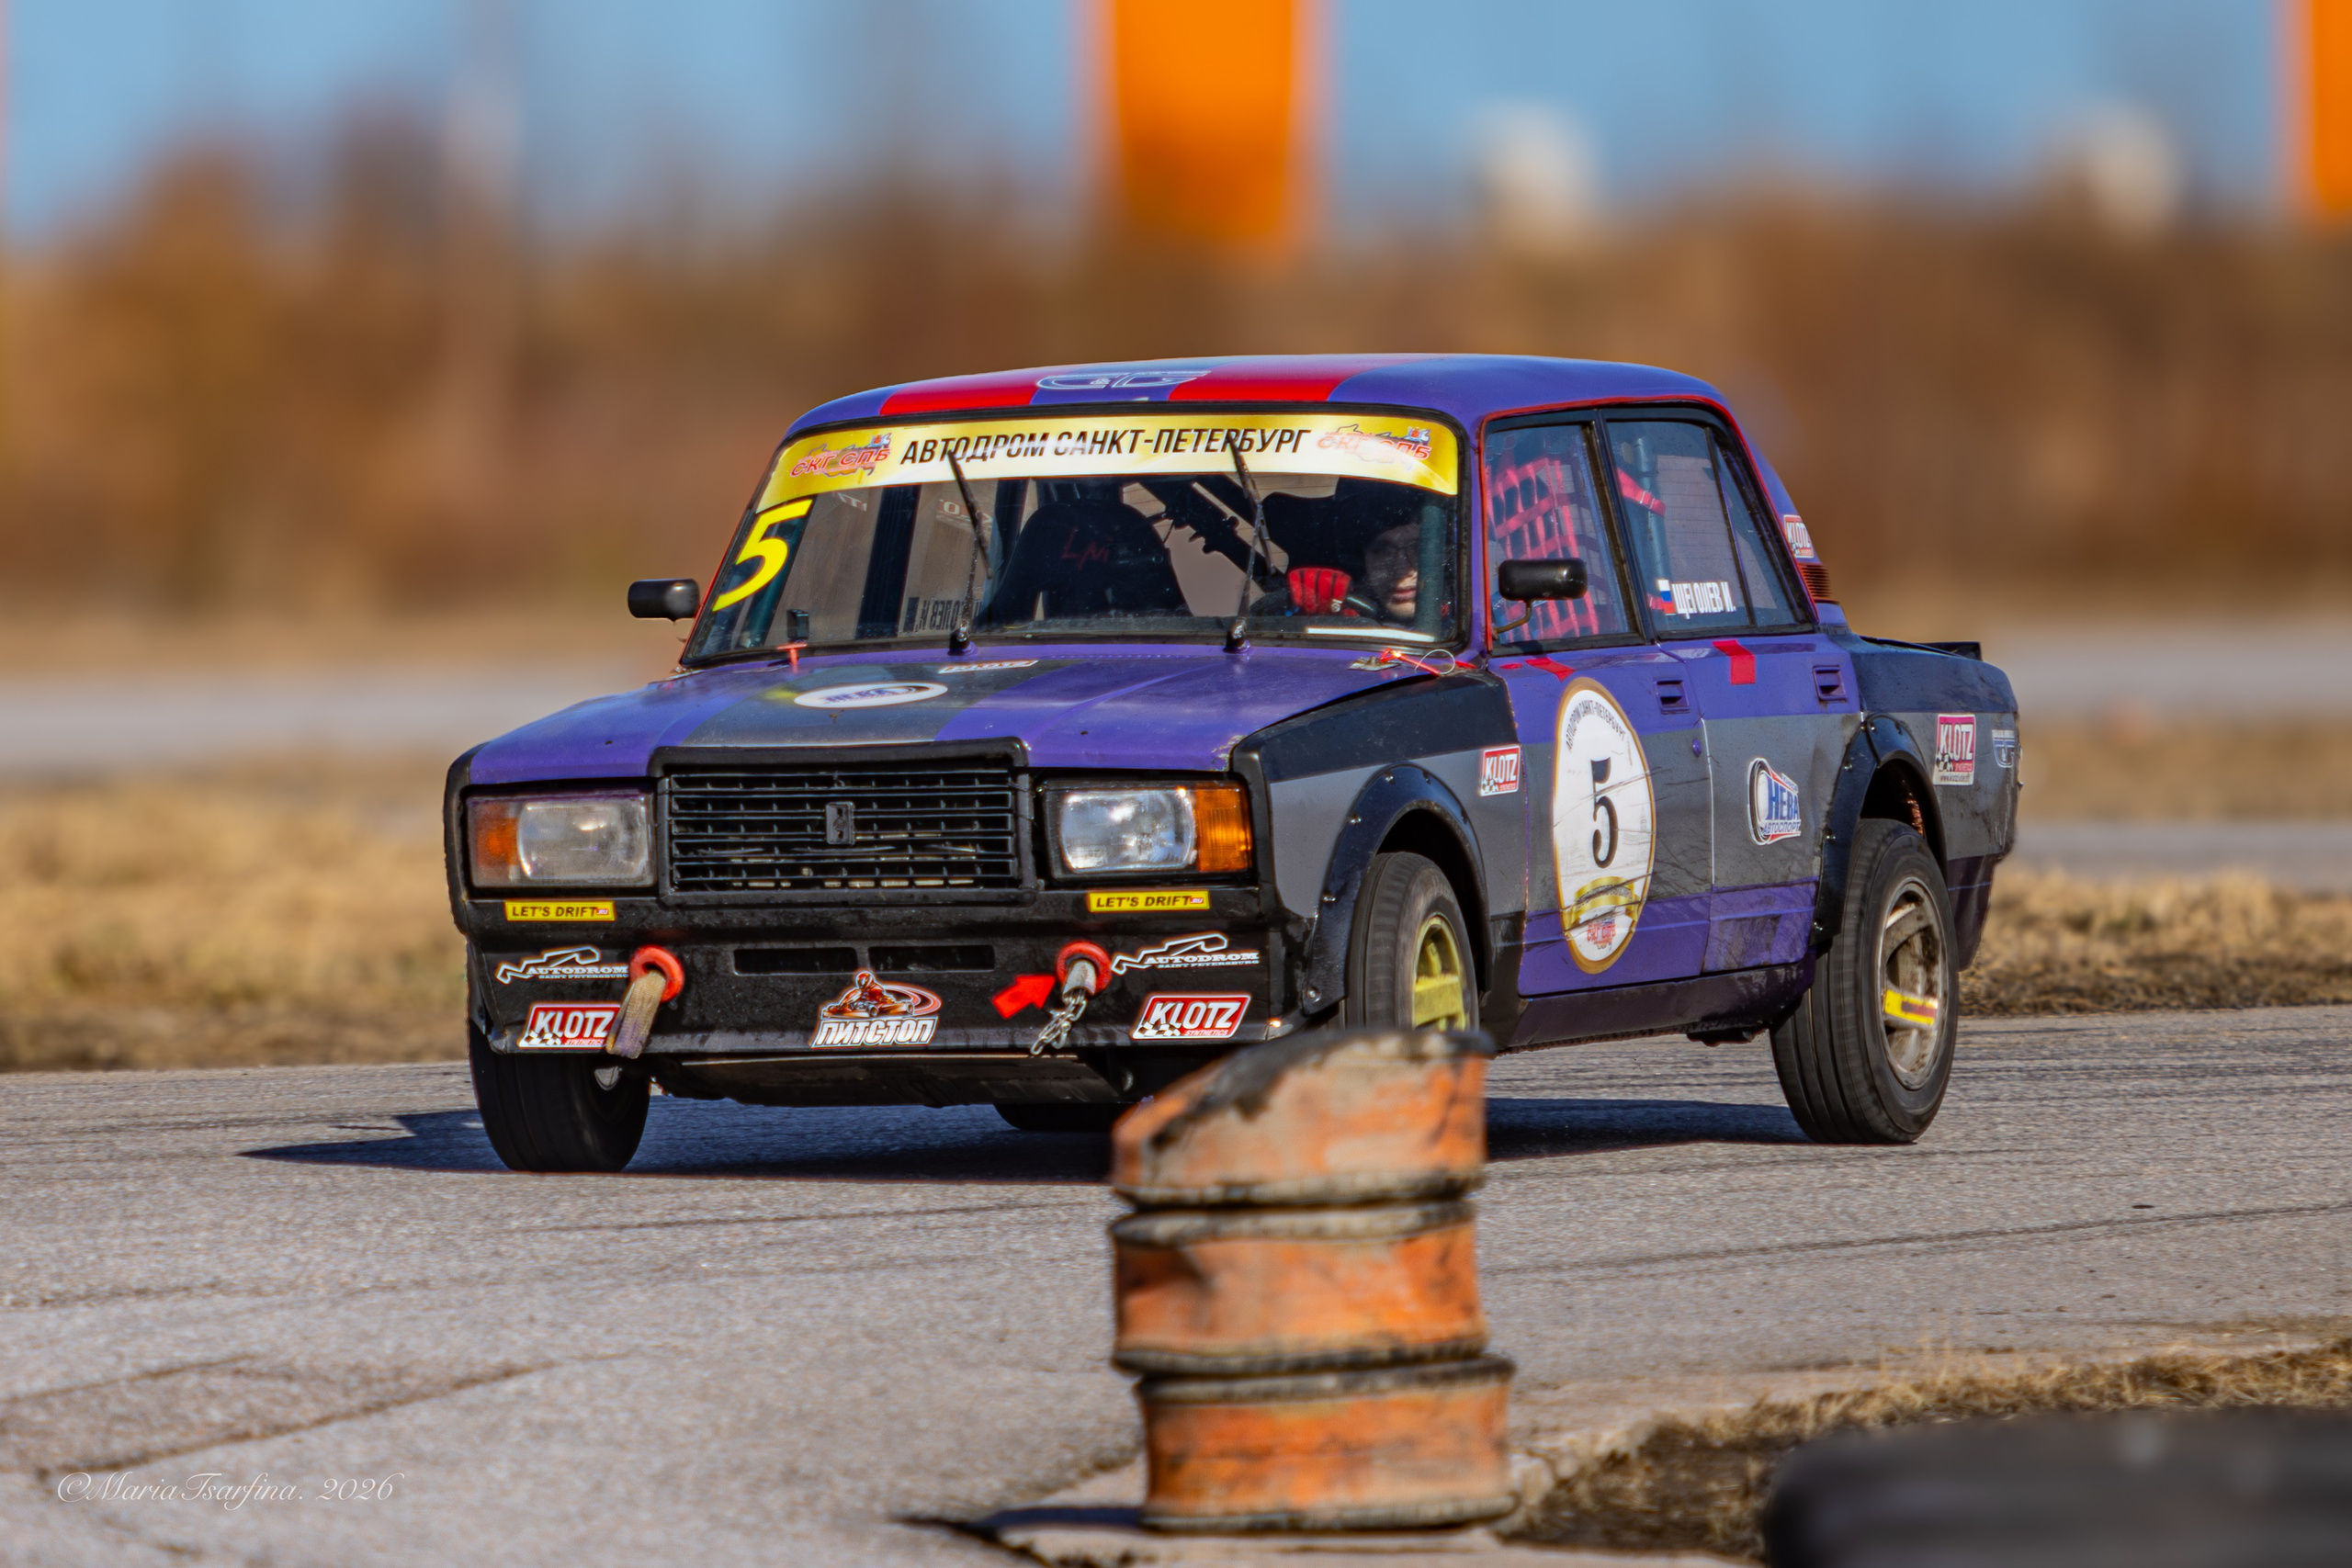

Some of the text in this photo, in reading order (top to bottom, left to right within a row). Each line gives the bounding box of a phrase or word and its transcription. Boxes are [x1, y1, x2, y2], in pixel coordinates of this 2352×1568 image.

[899, 428, 1312, 466] АВТОДРОМ САНКТ-ПЕТЕРБУРГ
[712, 499, 813, 613] 5
[1939, 723, 1973, 761] KLOTZ
[1485, 753, 1518, 784] KLOTZ
[1766, 772, 1799, 820] НЕВА
[1590, 756, 1619, 869] 5
[512, 907, 550, 917] LET'S
[1096, 897, 1139, 908] LET'S
[526, 965, 629, 975] AUTODROM
[1145, 952, 1261, 964] AUTODROM
[535, 1010, 615, 1038] KLOTZ
[1148, 1001, 1242, 1029] KLOTZ
[813, 1018, 936, 1047] ПИТСТОП
